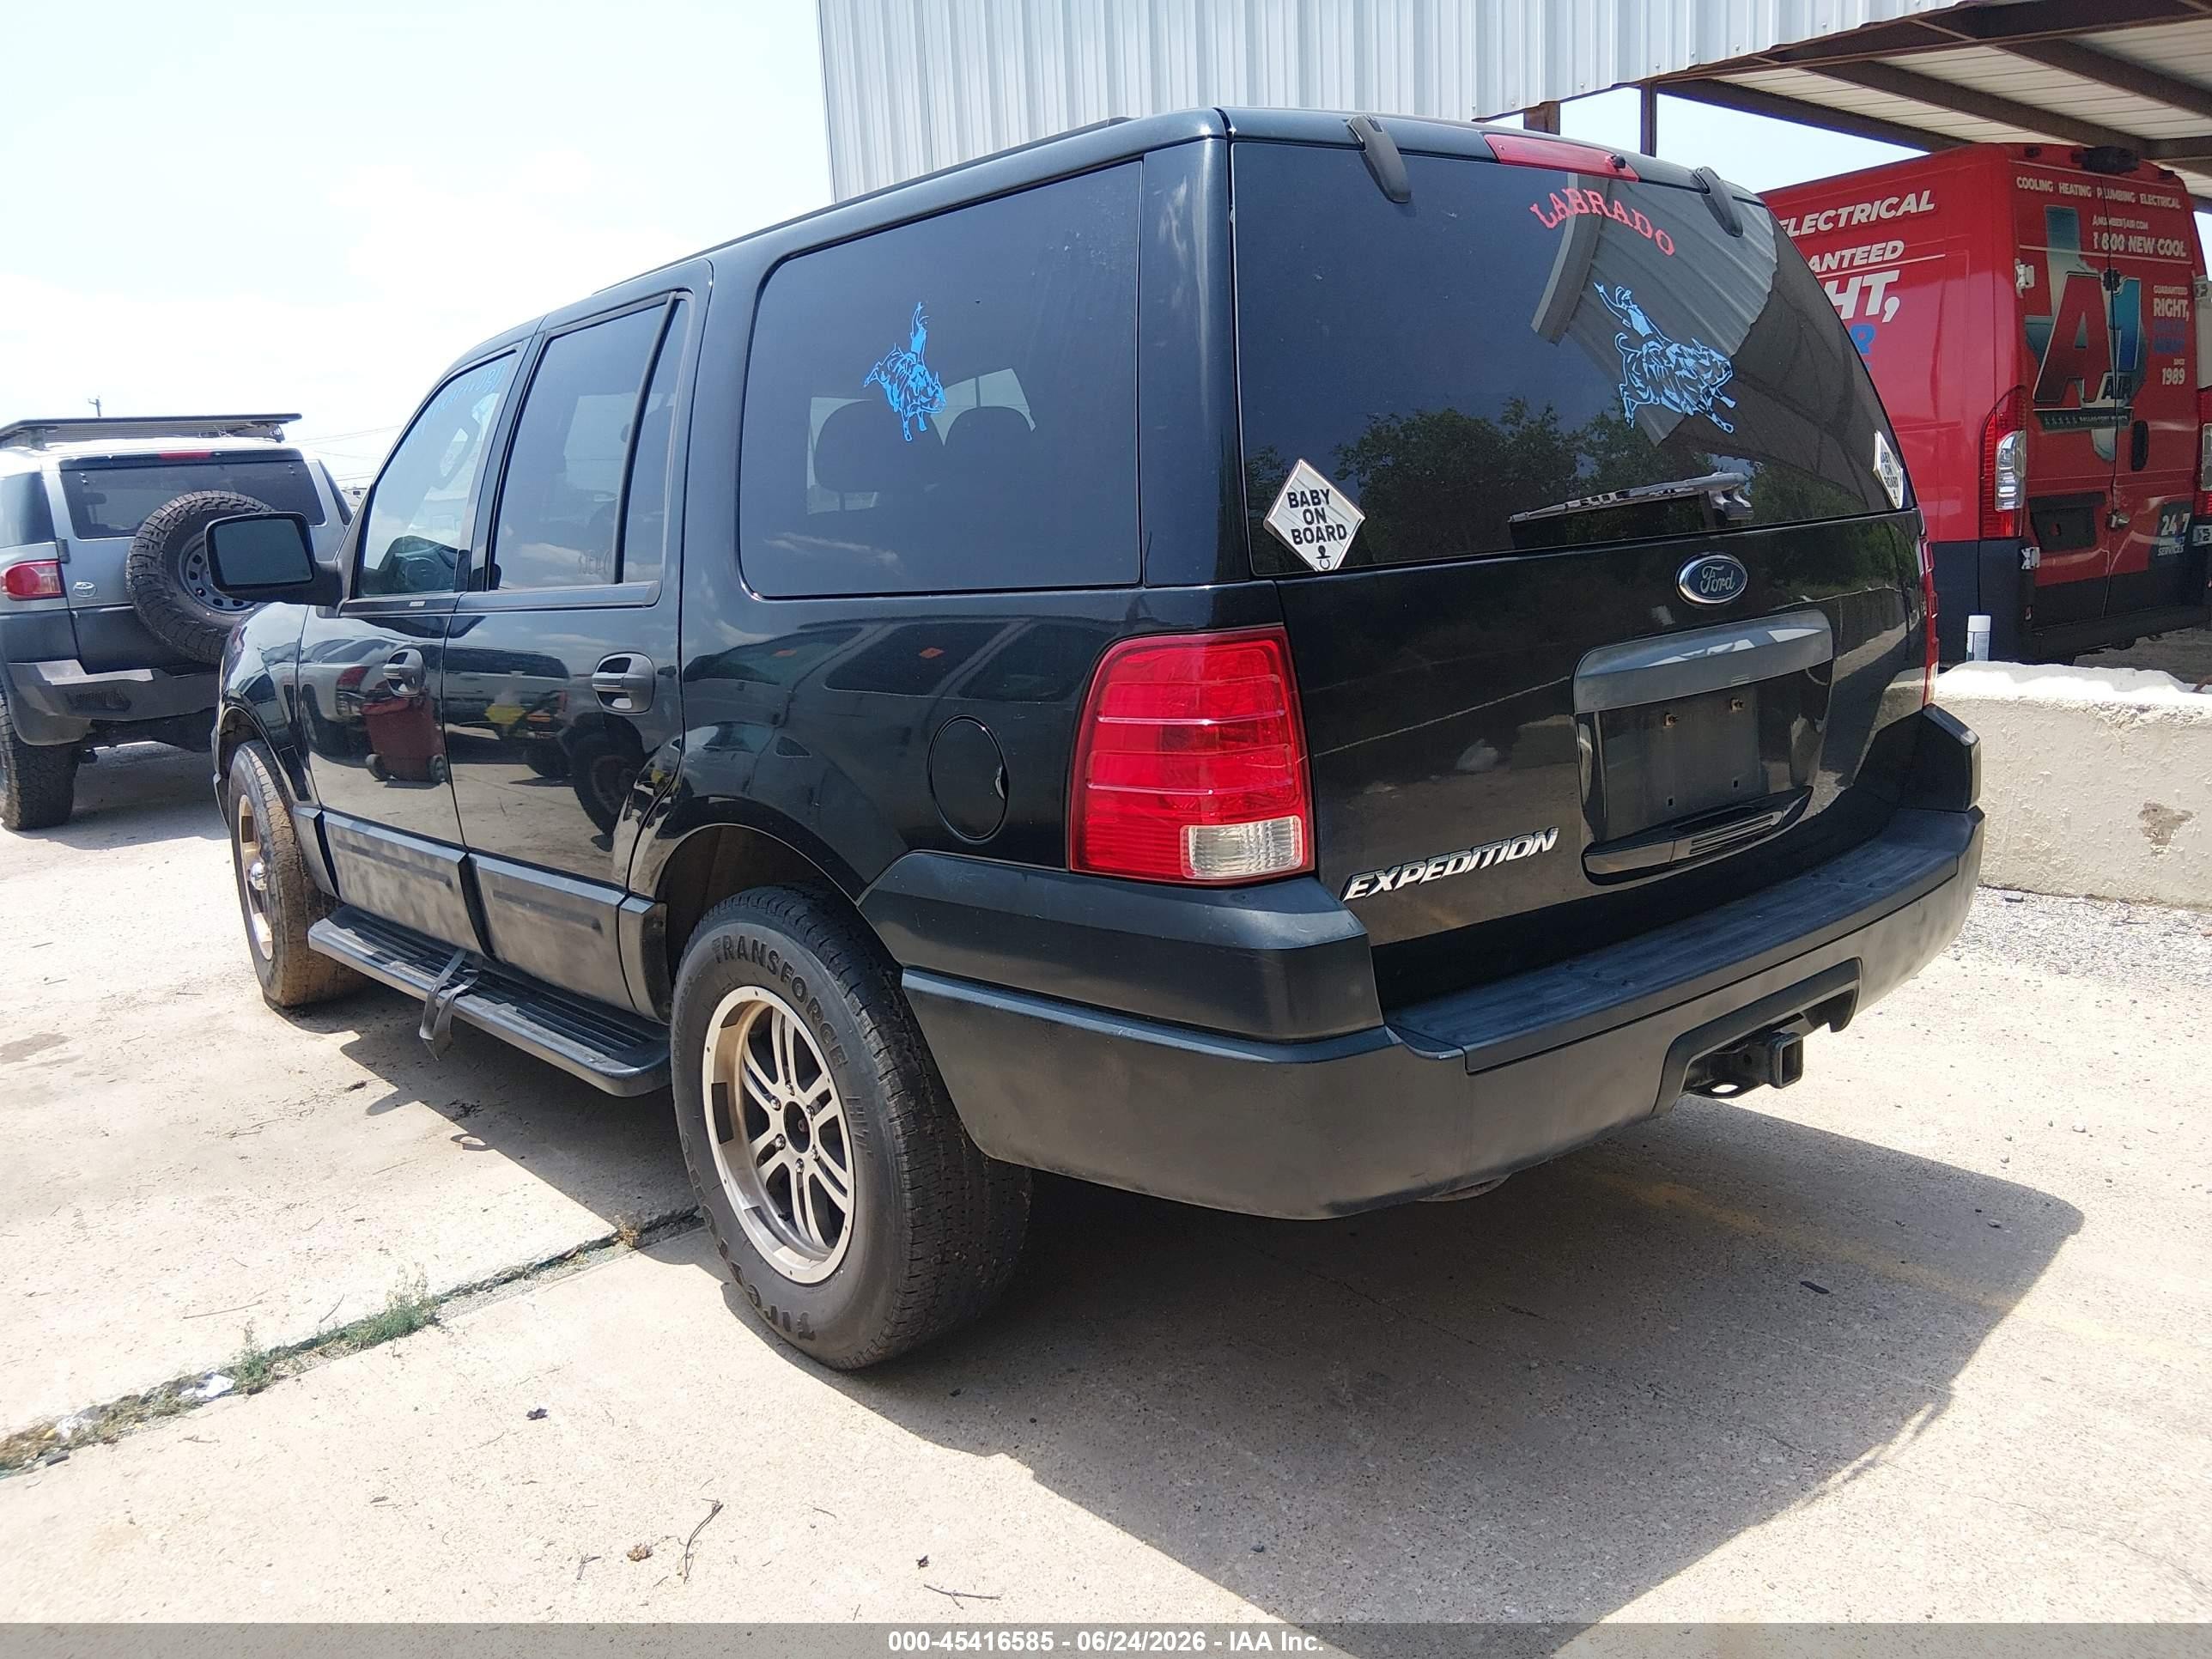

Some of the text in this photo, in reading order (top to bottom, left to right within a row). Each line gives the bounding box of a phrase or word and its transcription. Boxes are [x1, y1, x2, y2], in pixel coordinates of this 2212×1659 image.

[2016, 176, 2181, 209] COOLING HEATING PLUMBING ELECTRICAL
[1529, 188, 1675, 256] LABRADO
[2101, 233, 2125, 252] 800
[2128, 235, 2154, 254] NEW
[2157, 238, 2187, 258] COOL
[2153, 297, 2190, 322] RIGHT,
[2161, 367, 2185, 386] 1989
[1287, 489, 1330, 508] BABY
[1302, 507, 1328, 526] ON
[1291, 524, 1347, 545] BOARD
[1700, 565, 1735, 593] Ford
[1340, 826, 1559, 902] EXPEDITION
